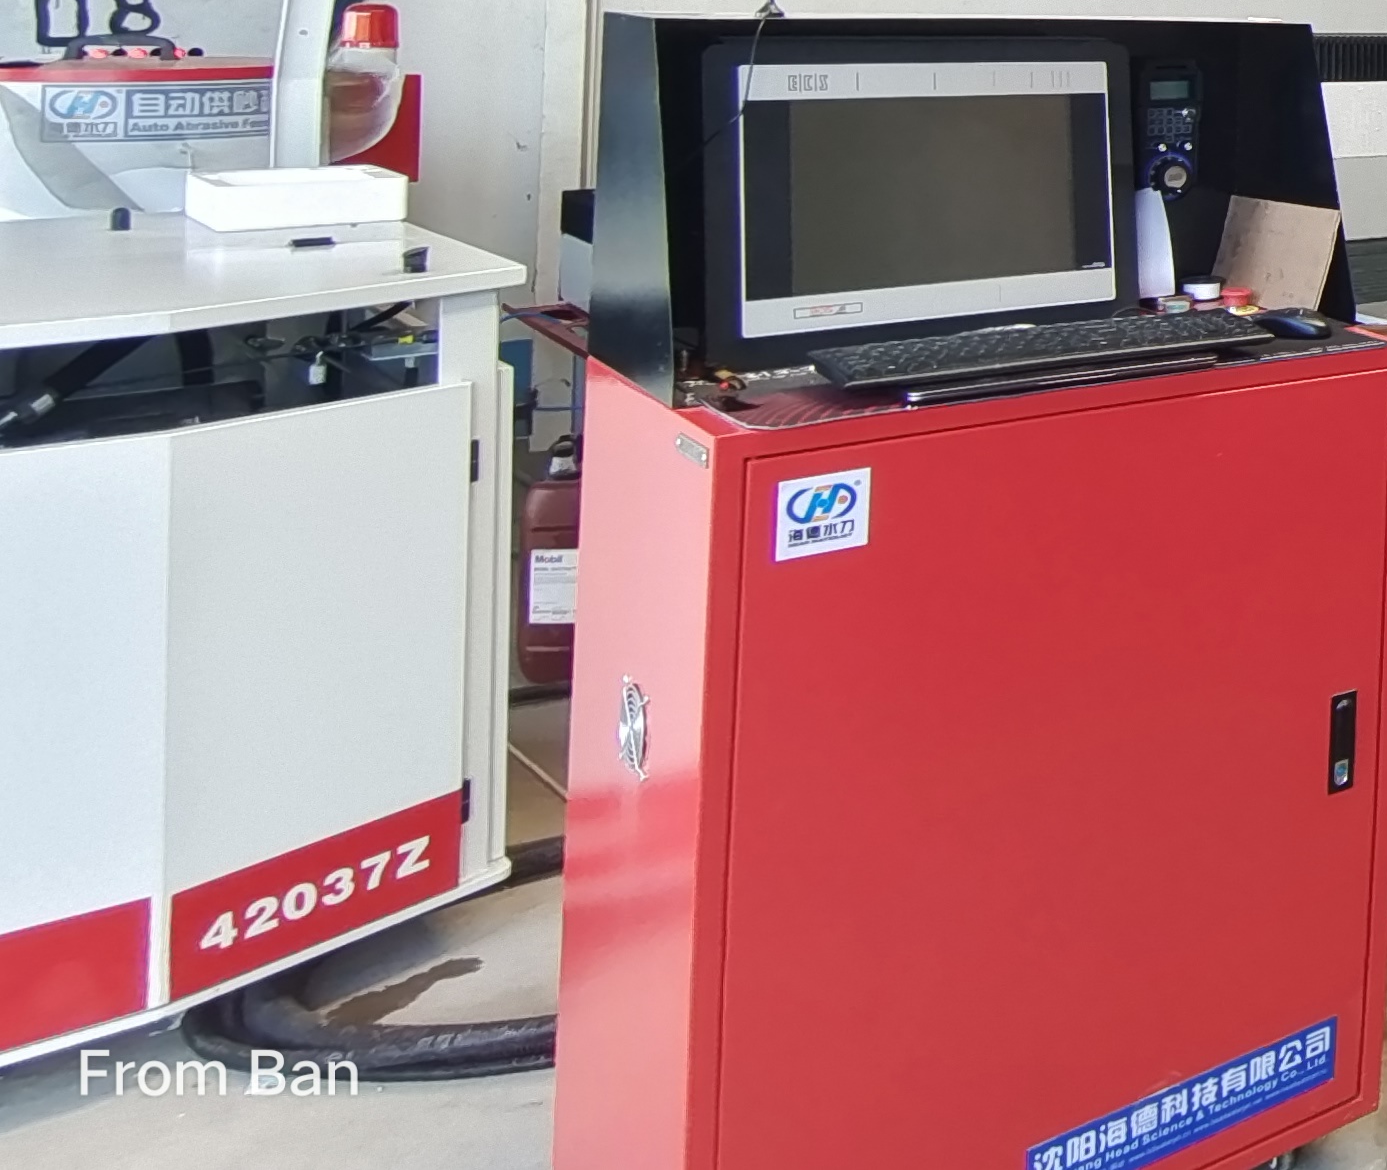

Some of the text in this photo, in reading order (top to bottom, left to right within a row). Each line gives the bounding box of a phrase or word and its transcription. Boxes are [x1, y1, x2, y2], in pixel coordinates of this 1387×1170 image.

[130, 120, 170, 134] Auto
[174, 116, 238, 132] Abrasive
[199, 835, 431, 950] 42037Z
[1105, 1139, 1139, 1163] Head
[1142, 1116, 1193, 1146] Science
[1208, 1077, 1279, 1115] Technology
